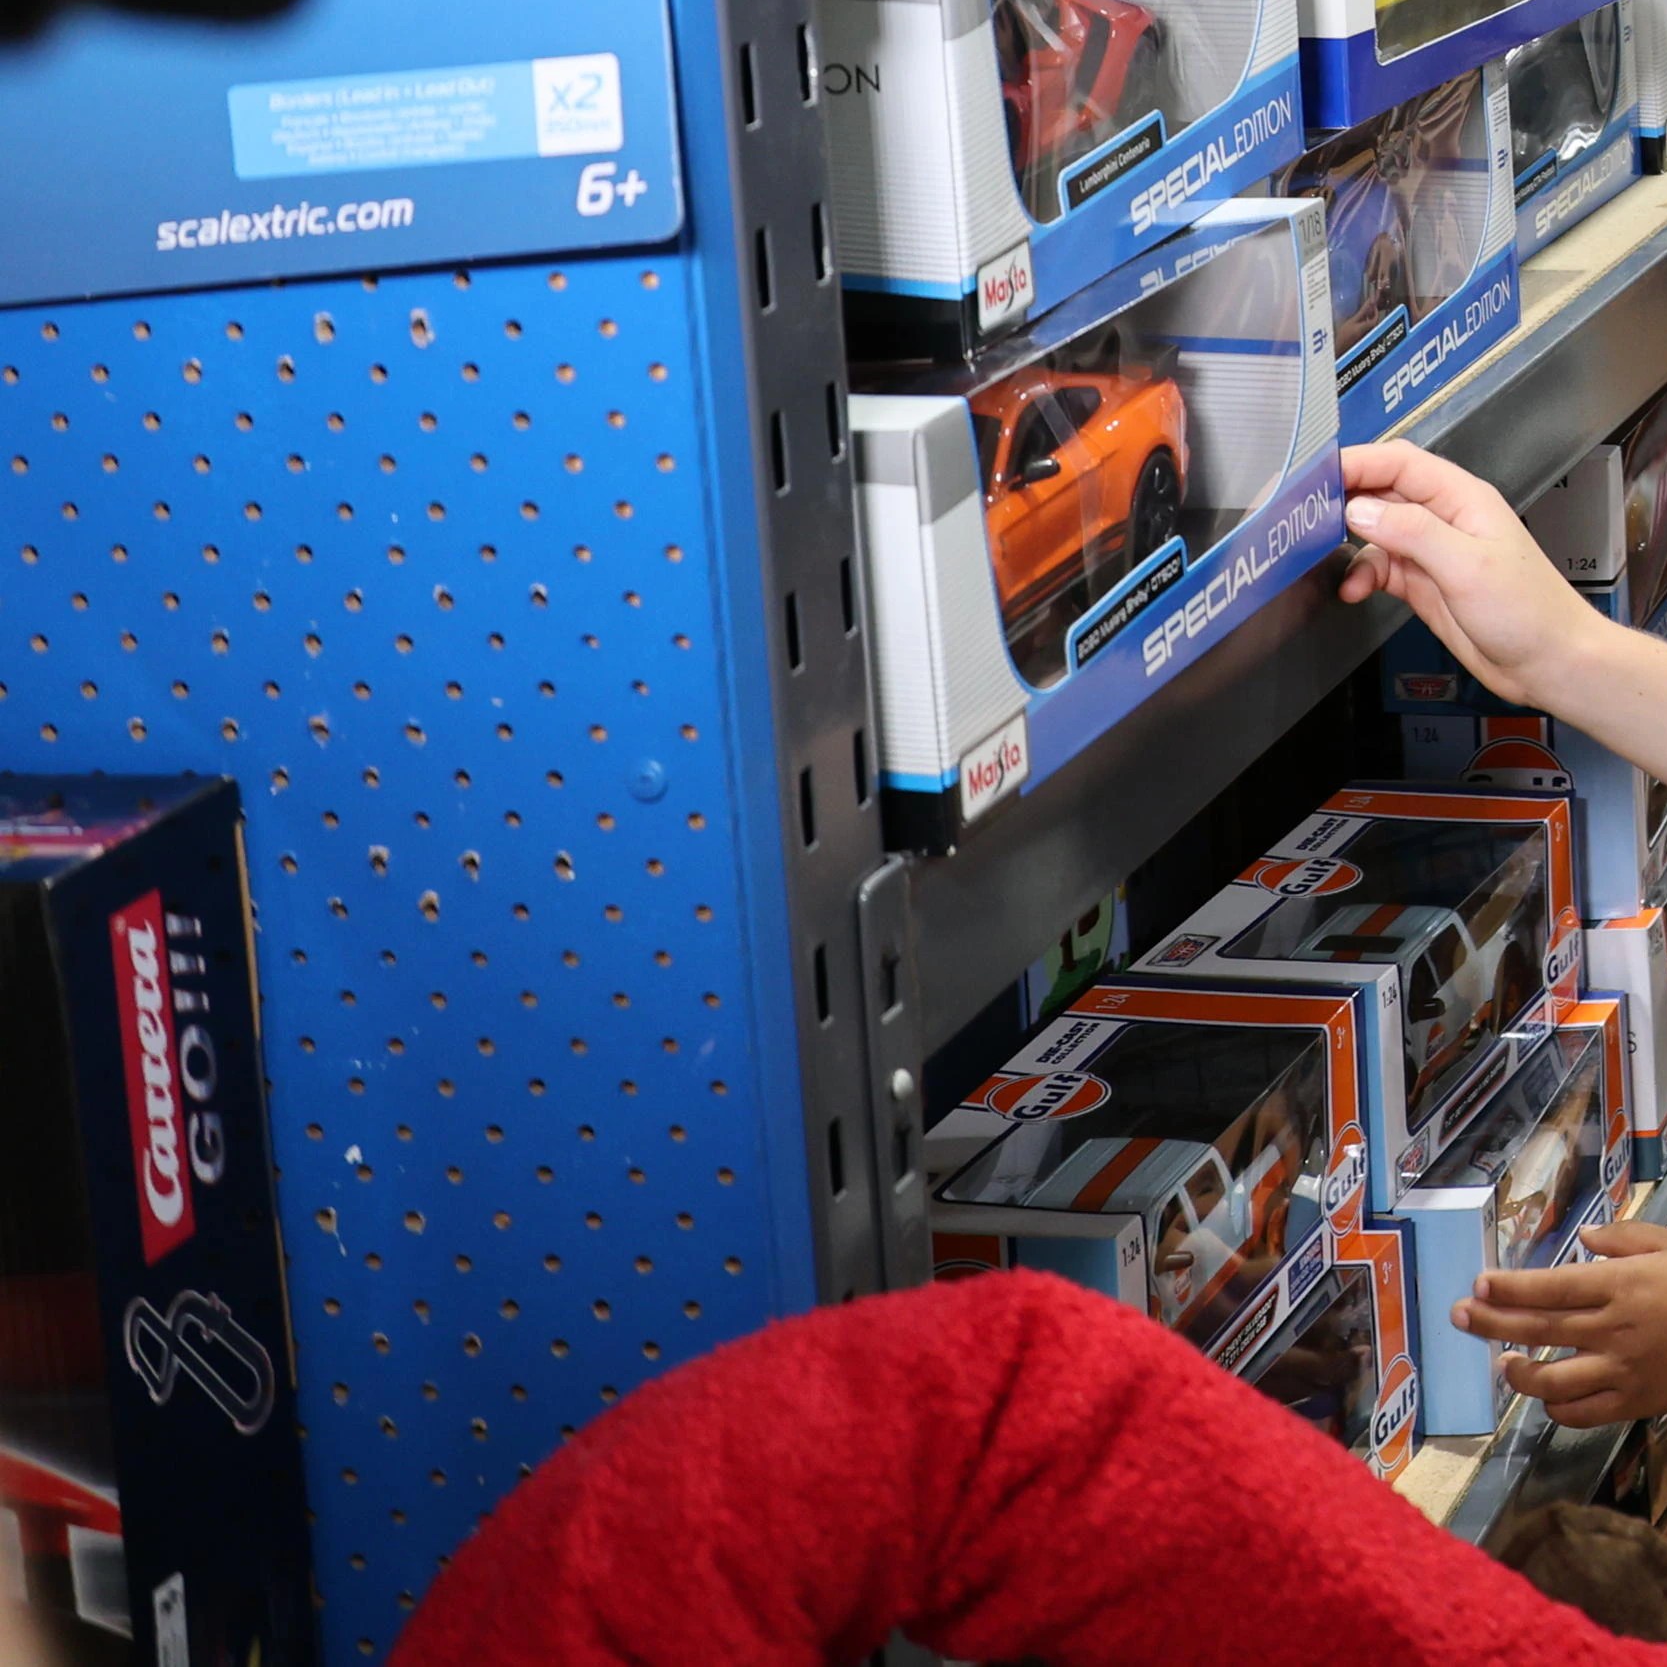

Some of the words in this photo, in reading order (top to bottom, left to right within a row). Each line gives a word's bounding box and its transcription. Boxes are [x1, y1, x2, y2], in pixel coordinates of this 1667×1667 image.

[549, 72, 604, 112] x2
[1079, 158, 1118, 194] Lamborghini
[1117, 137, 1151, 170] Centenario
[575, 161, 648, 217] 6+
[156, 198, 414, 252] scalextric.com
[984, 264, 1027, 311] Maisto
[1567, 557, 1597, 571] 1:24
[1100, 606, 1127, 640] Mustang
[967, 741, 1021, 801] Maisto
[1296, 817, 1341, 852] DIE-CAST
[1308, 819, 1351, 853] COLLECTION
[1280, 857, 1340, 896] Gulf
[1546, 926, 1581, 983] Gulf
[1382, 981, 1399, 1010] 1:24
[1036, 1020, 1089, 1065] DIE-CAST
[1051, 1022, 1102, 1065] COLLECTION
[131, 920, 184, 1228] Carrera
[1013, 1071, 1086, 1120] Gulf
[1324, 1146, 1369, 1210] Gulf
[1604, 1142, 1633, 1185] Gulf
[1121, 1239, 1142, 1268] 1:24
[1373, 1376, 1420, 1451] Gulf
